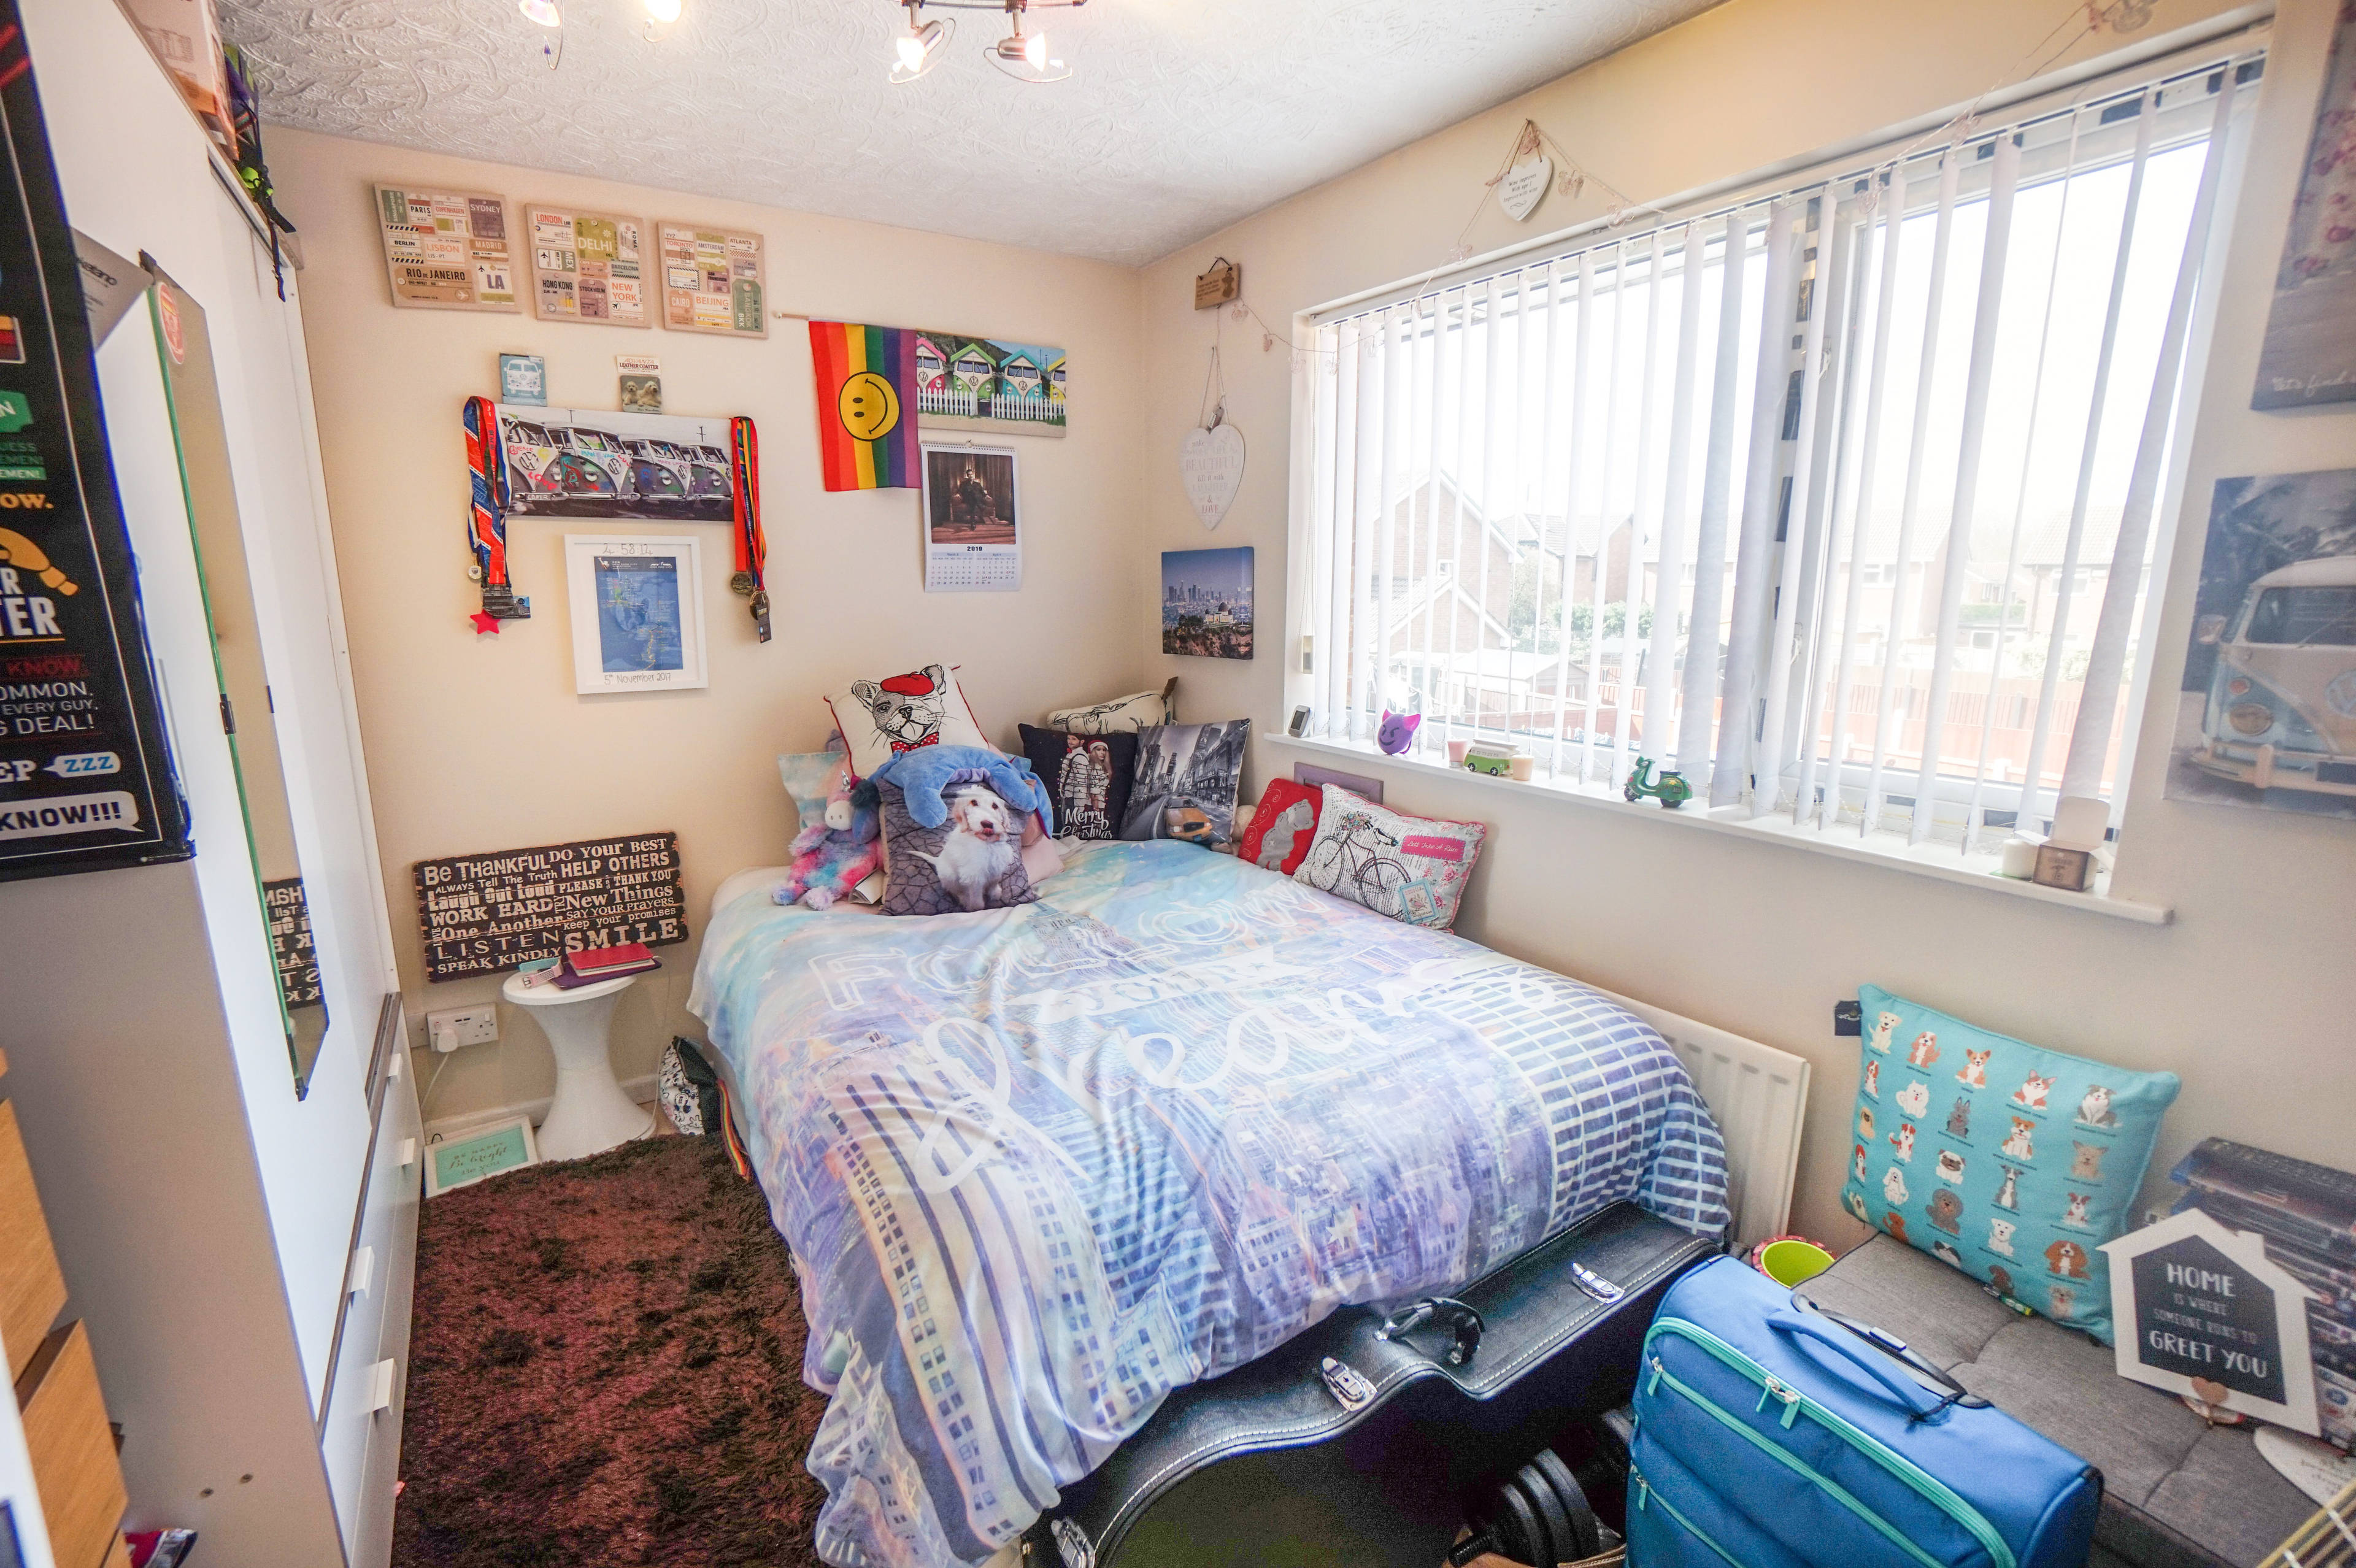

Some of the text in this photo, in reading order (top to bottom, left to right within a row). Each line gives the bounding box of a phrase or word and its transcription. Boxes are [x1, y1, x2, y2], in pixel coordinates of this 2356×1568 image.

[436, 206, 464, 215] COPENHAGEN
[470, 204, 501, 213] SYDNEY
[536, 213, 563, 224] LONDON
[426, 244, 460, 253] LISBON
[475, 240, 502, 249] MADRID
[578, 237, 612, 252] DELHI
[666, 240, 693, 249] TORONTO
[698, 242, 724, 251] AMSTERDAM
[564, 252, 574, 269] MEX
[406, 268, 422, 278] RIO
[429, 270, 465, 280] JANEIRO
[487, 274, 505, 290] LA
[542, 280, 573, 290] HONG KONG
[612, 282, 633, 291] NEW
[612, 292, 637, 301] YORK
[672, 297, 690, 307] CAIRO
[696, 297, 729, 307] BEIJING
[744, 293, 752, 328] BANGKOK
[617, 673, 654, 684] November
[656, 672, 671, 682] 2017
[2, 702, 56, 715] EVERY
[15, 713, 94, 735] DEAL!
[0, 801, 122, 831] KNOW!!!
[1065, 807, 1109, 830] Merry
[1052, 823, 1112, 839] Christmas
[424, 866, 452, 885] Be
[549, 849, 574, 863] DO
[435, 851, 670, 894] ALWAYS Tell The Truth HELP OTHERS
[427, 890, 480, 912] Laugh
[485, 886, 513, 904] Out
[517, 880, 555, 900] Loud
[559, 878, 603, 894] PLEASE
[614, 872, 649, 886] THANK
[650, 869, 672, 882] YOU
[429, 906, 489, 927] WORK
[498, 898, 554, 918] HARD
[553, 894, 566, 914] TRY
[565, 893, 609, 910] New
[563, 906, 676, 931] keep your promises
[441, 926, 479, 940] One
[489, 914, 563, 934] Another
[437, 917, 679, 960] LISTEN SMILE
[437, 947, 561, 974] SPEAK KINDLY
[2167, 1262, 2236, 1297] HOME
[2149, 1330, 2267, 1378] GREET YOU
